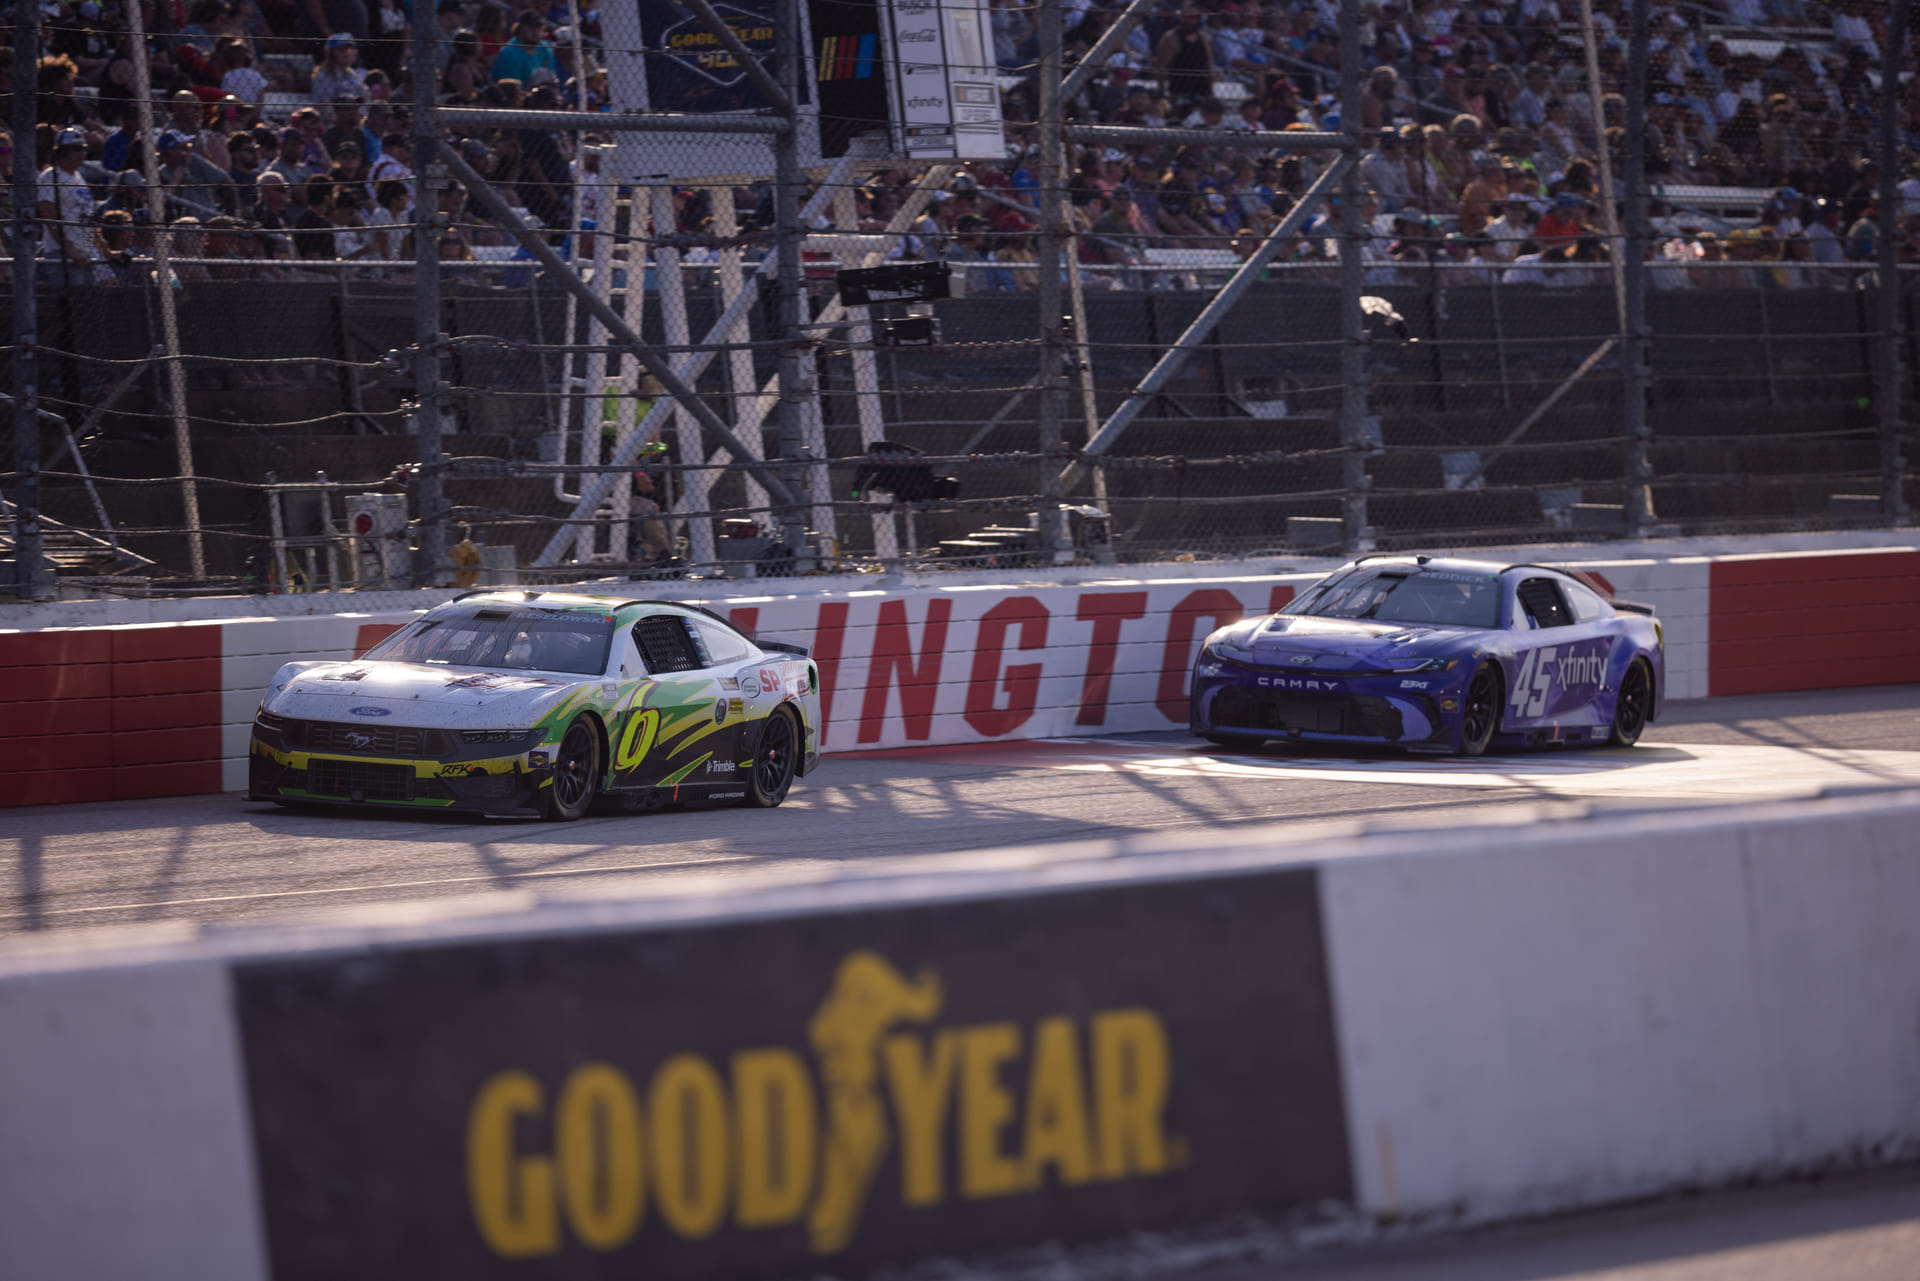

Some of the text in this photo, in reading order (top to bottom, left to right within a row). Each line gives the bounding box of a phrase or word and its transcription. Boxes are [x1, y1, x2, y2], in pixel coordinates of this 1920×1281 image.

[1419, 571, 1485, 583] REDDICK
[1556, 646, 1609, 692] xfinity
[1257, 677, 1338, 690] CAMRY
[1510, 647, 1557, 718] 45
[440, 763, 472, 775] RFK
[713, 759, 736, 772] Trimble
[467, 1008, 1168, 1258] GOODYEAR
